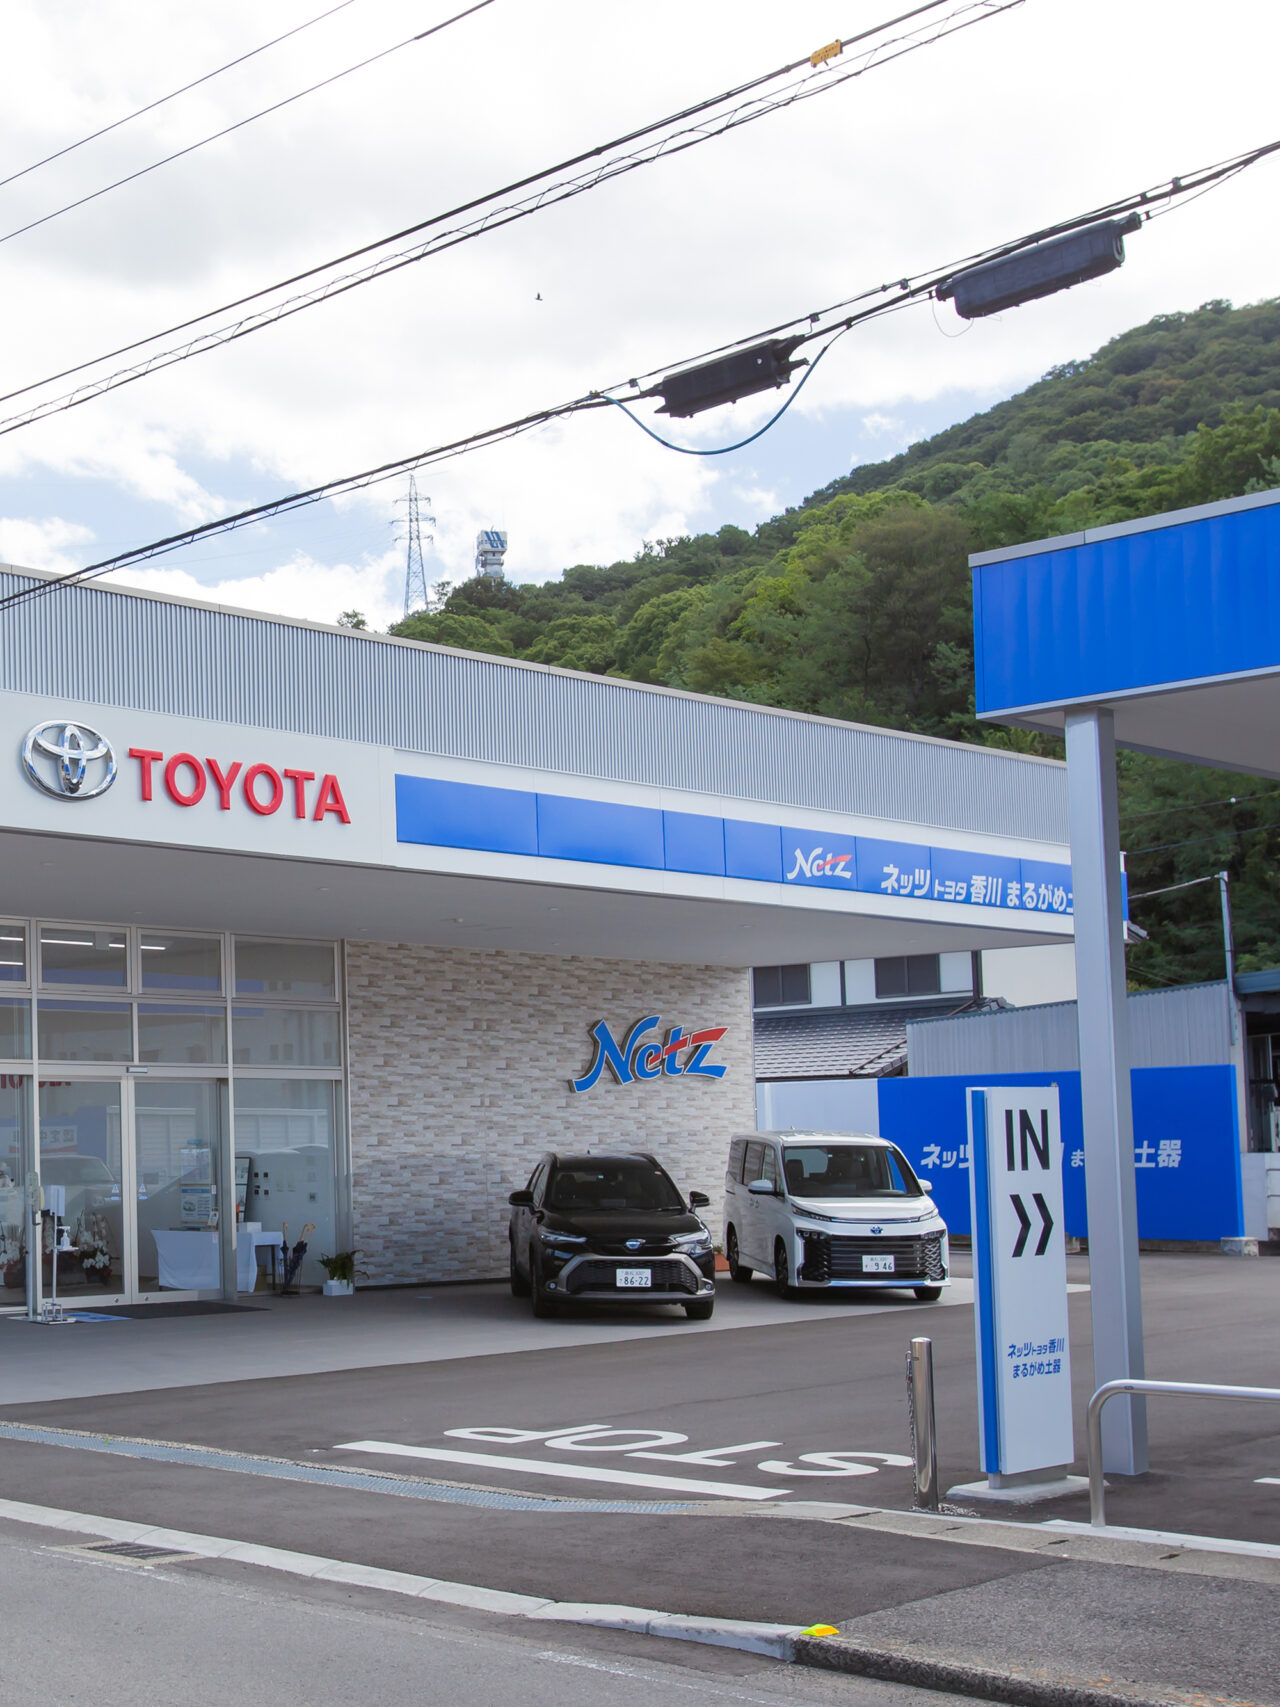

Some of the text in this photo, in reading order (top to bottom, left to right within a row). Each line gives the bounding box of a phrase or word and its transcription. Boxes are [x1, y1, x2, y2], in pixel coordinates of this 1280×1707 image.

[128, 747, 351, 824] TOYOTA
[786, 847, 852, 880] Netz
[1007, 881, 1074, 914] まるがめ
[570, 1014, 730, 1093] Netz
[1004, 1109, 1050, 1171] IN
[1008, 1337, 1064, 1359] ネッツトヨタ香川
[1013, 1358, 1061, 1379] まるがめ土器
[443, 1423, 914, 1477] STOP
